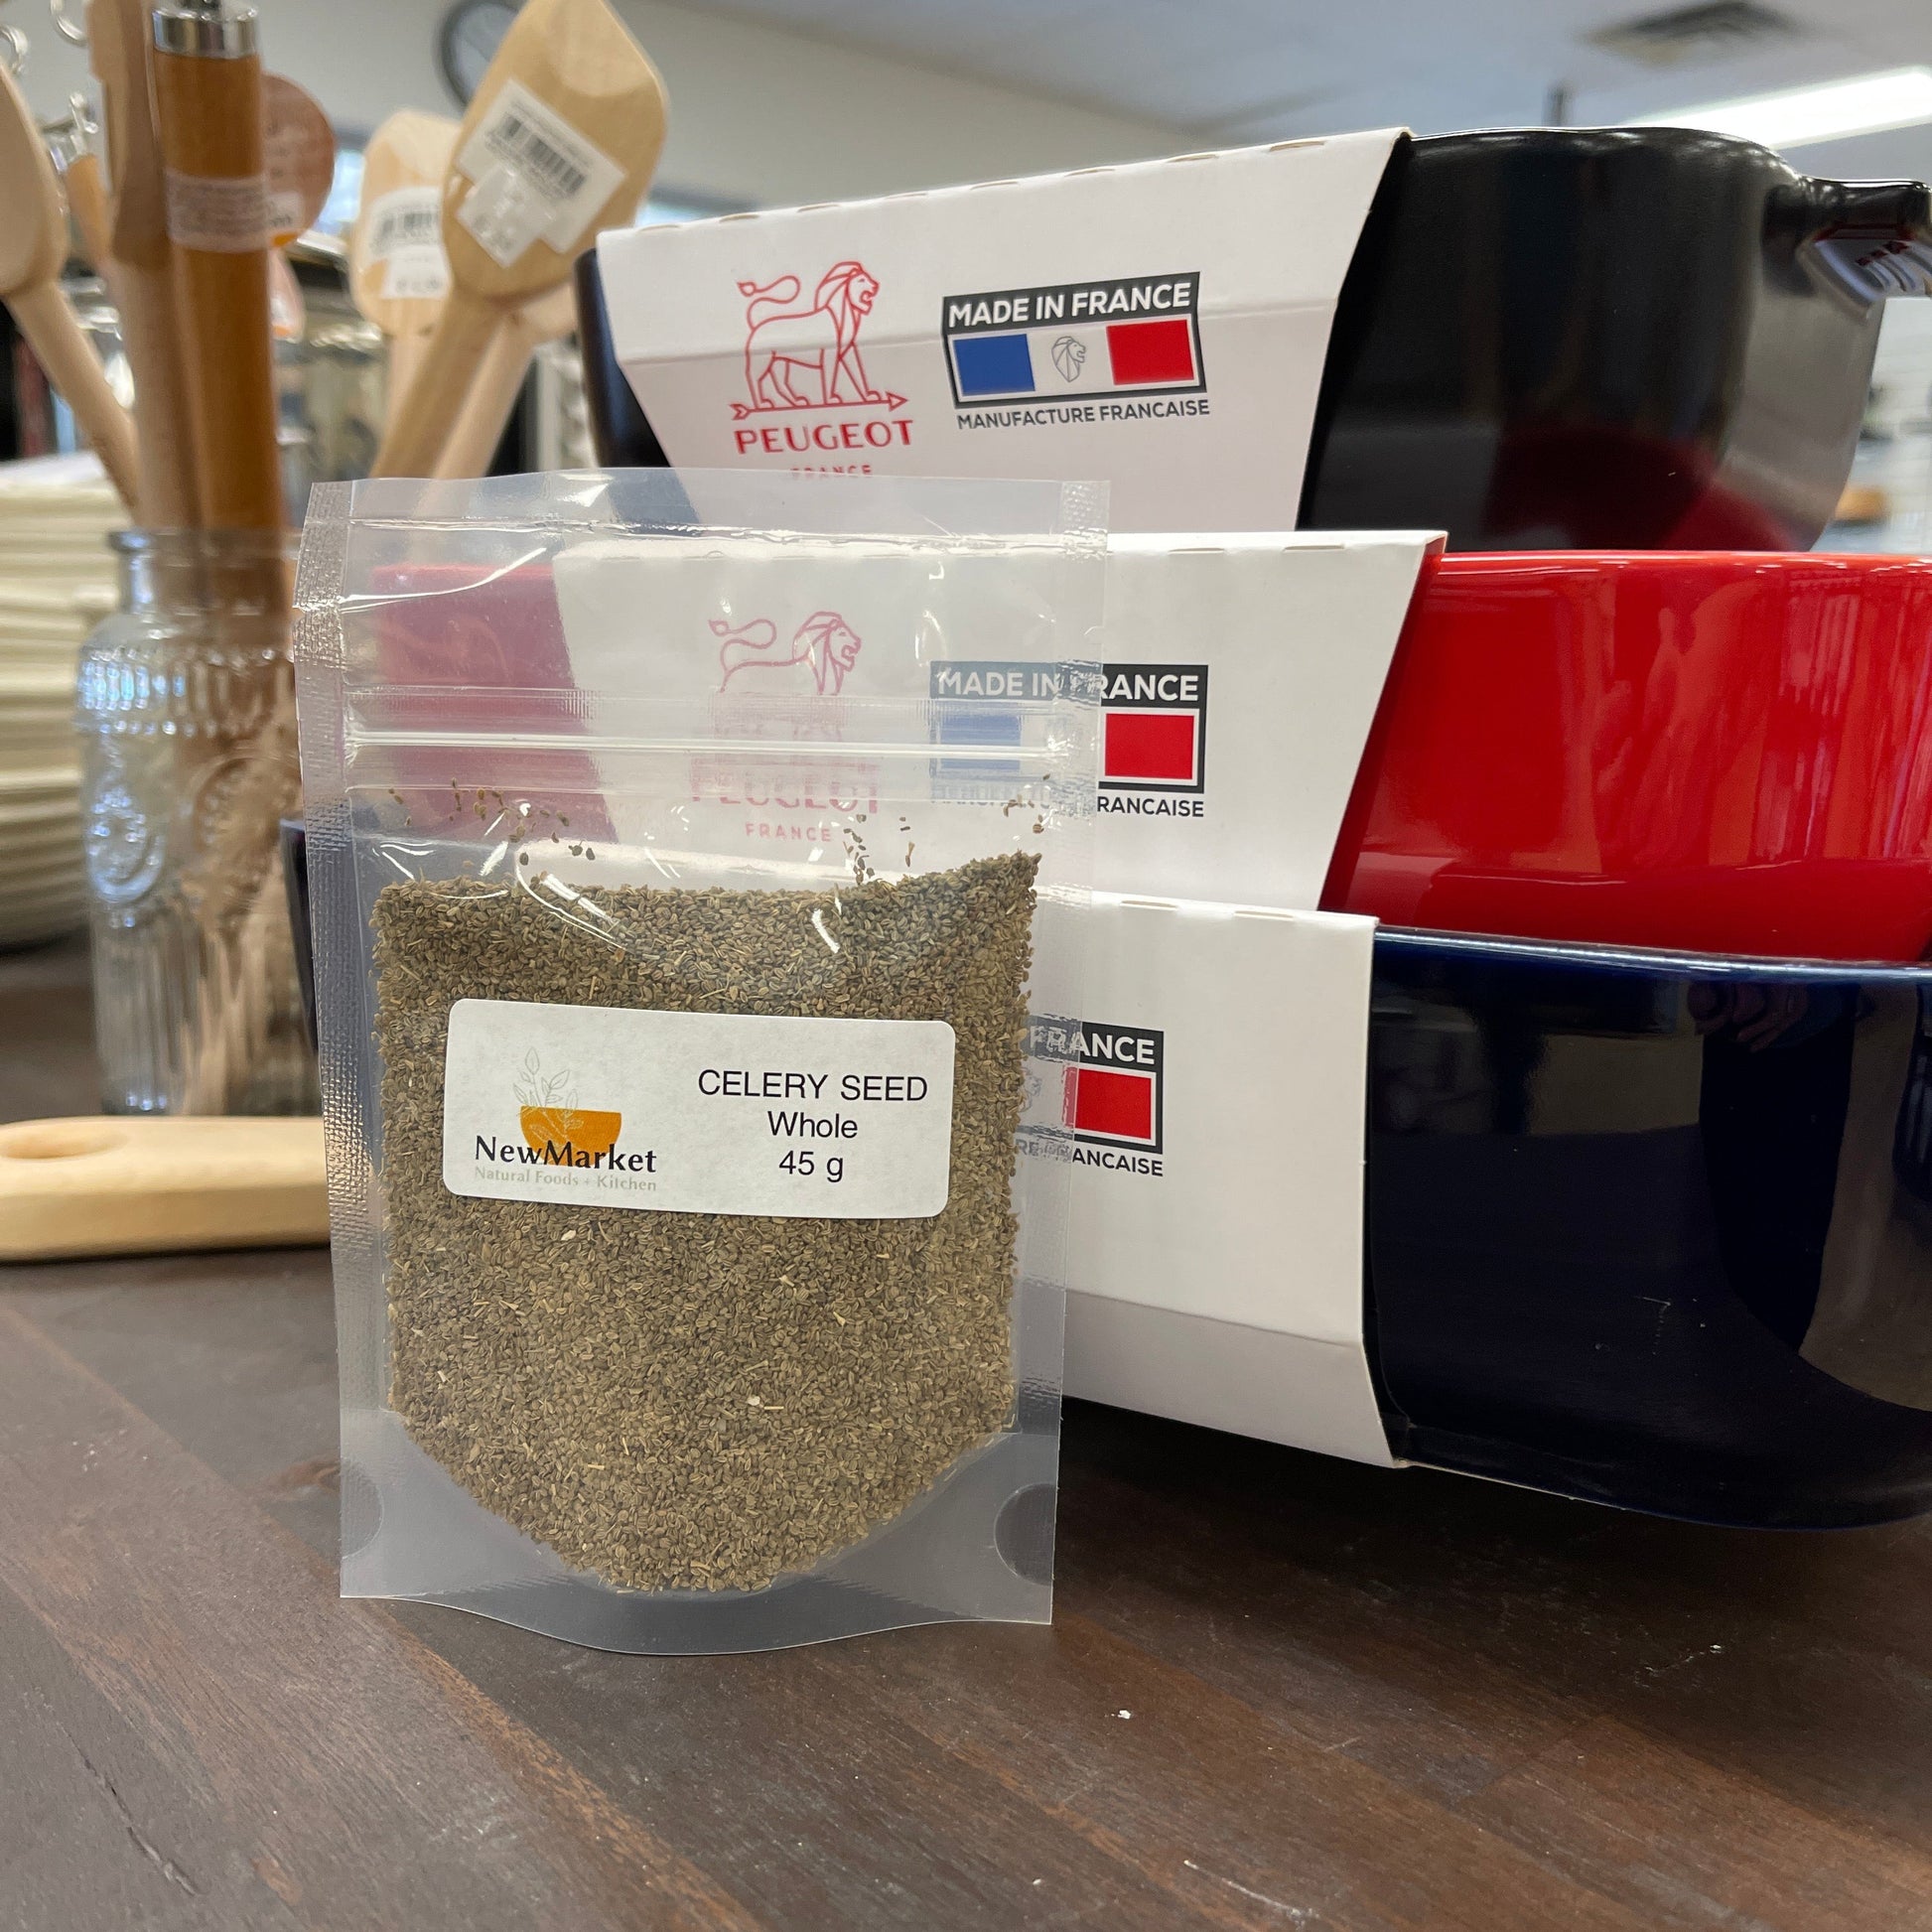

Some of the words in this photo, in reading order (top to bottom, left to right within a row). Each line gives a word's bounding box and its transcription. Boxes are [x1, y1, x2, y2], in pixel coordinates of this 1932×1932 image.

[948, 298, 1030, 329] MADE
[1035, 294, 1064, 320] IN
[1070, 282, 1191, 317] FRANCE
[956, 406, 1096, 430] MANUFACTURE
[1100, 399, 1210, 421] FRANCAISE
[734, 420, 913, 455] PEUGEOT
[937, 672, 1024, 697] MADE
[1032, 672, 1061, 698] IN
[1080, 793, 1204, 818] RANCAISE
[746, 822, 832, 843] FRANCE
[698, 1068, 829, 1099] CELERY
[840, 1074, 928, 1101] SEED
[767, 1110, 858, 1139] Whole
[475, 1135, 657, 1173] NewMarket
[778, 1150, 815, 1175] 45
[826, 1157, 844, 1183] g
[475, 1166, 530, 1183] Natural
[535, 1170, 579, 1186] Foods
[597, 1174, 657, 1191] Kitchen
